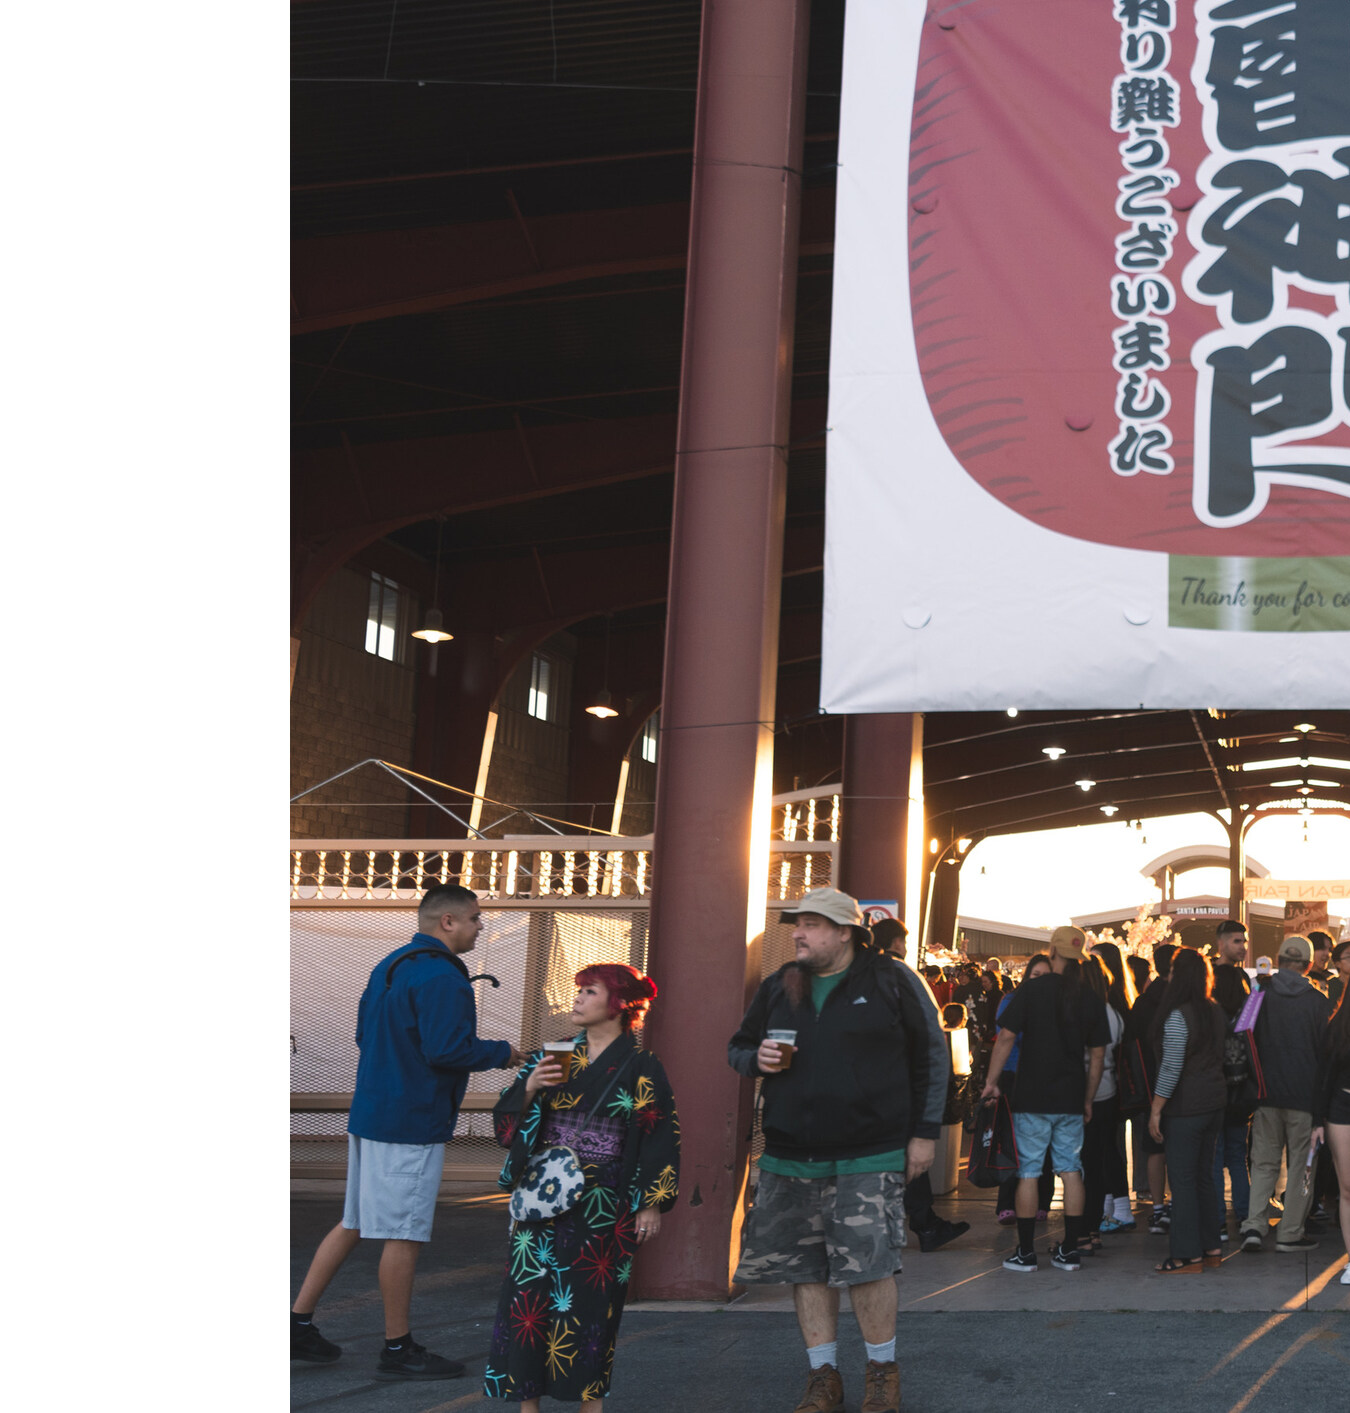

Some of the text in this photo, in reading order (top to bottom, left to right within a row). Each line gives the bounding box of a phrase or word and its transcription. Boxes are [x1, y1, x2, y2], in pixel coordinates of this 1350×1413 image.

[1181, 576, 1248, 608] Thank
[1253, 591, 1289, 616] you
[1292, 580, 1327, 616] for
[1176, 907, 1230, 915] SANTA ANA PAVILIO
